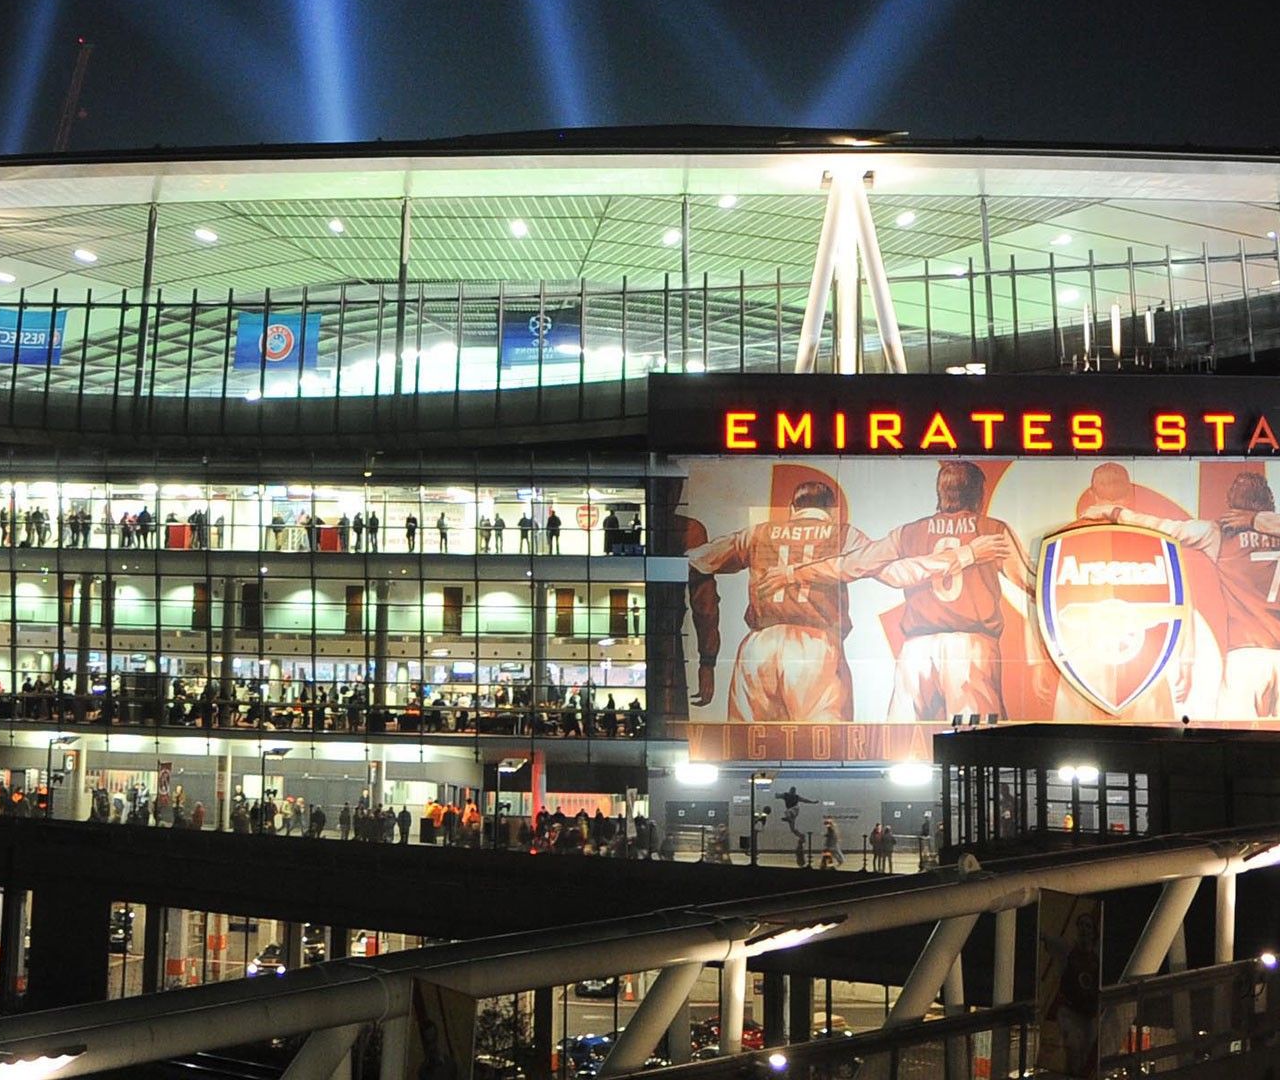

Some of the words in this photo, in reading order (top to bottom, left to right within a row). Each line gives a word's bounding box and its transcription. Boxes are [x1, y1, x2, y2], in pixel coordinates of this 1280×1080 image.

[724, 411, 1106, 451] EMIRATES
[771, 525, 833, 541] BASTIN
[927, 516, 977, 535] ADAMS
[1057, 555, 1168, 586] Arsenal
[688, 724, 934, 762] VICTORIA
